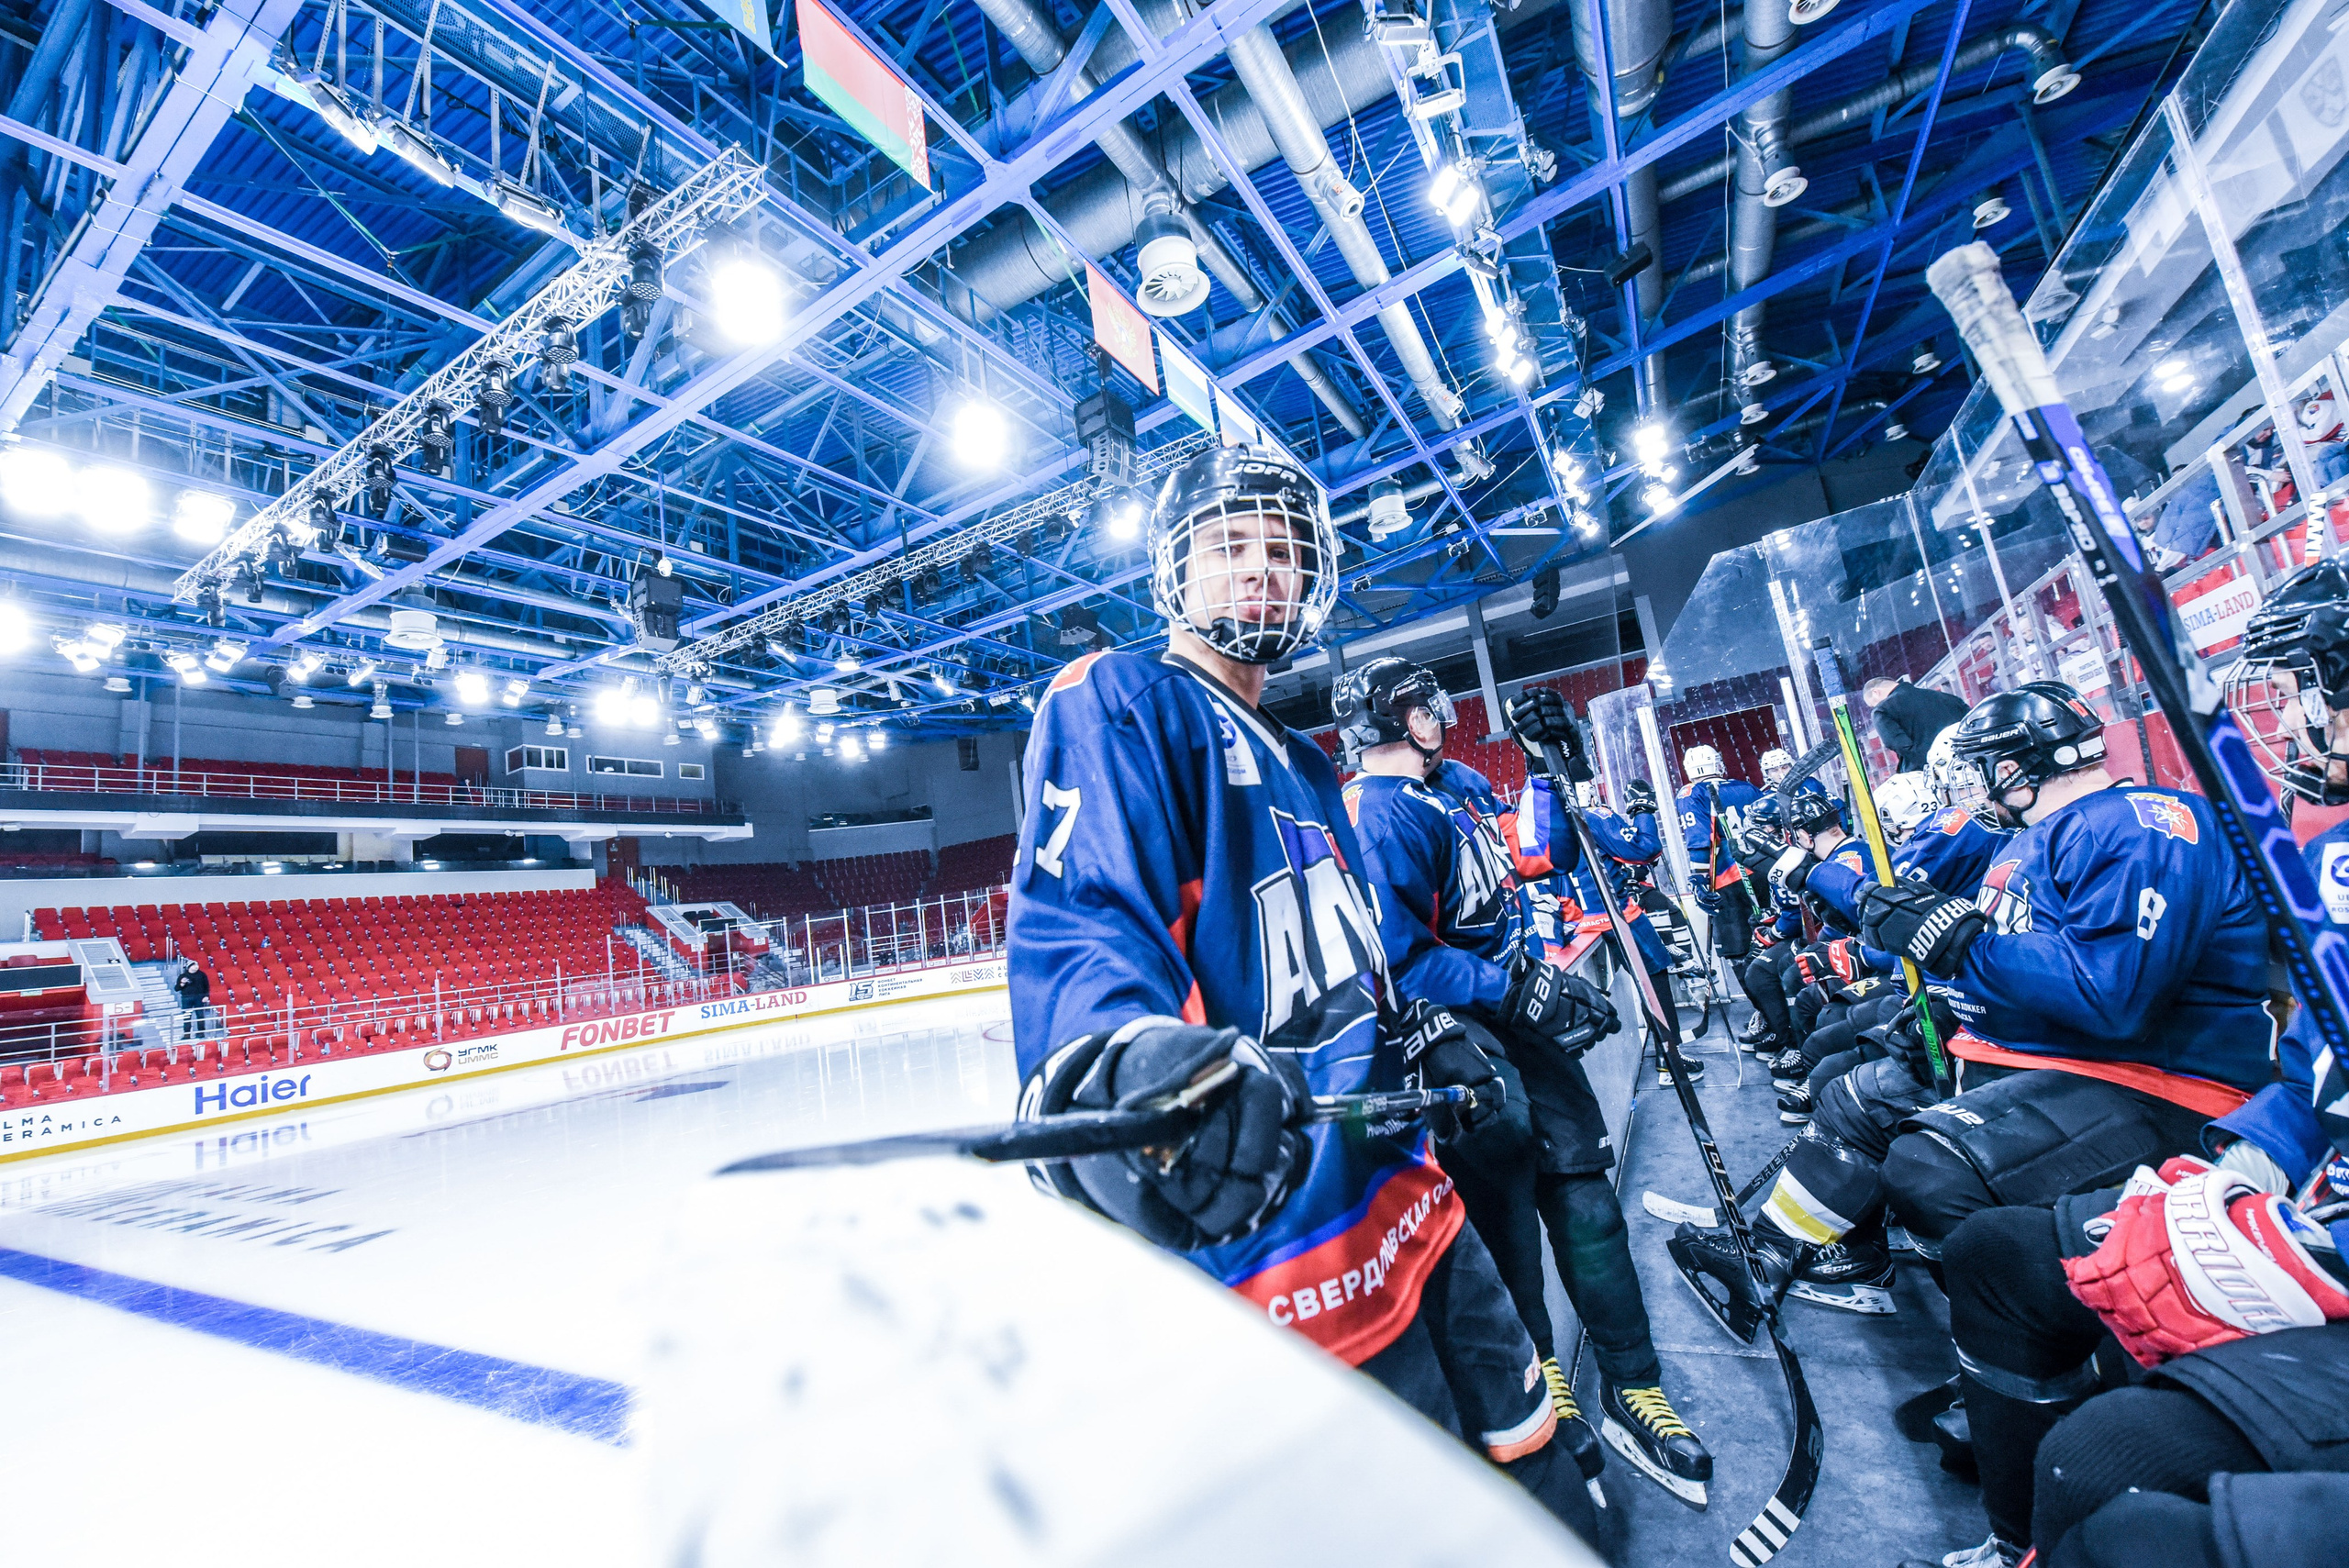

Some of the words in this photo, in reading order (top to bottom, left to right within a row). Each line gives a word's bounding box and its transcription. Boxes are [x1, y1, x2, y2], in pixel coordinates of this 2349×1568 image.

[1225, 462, 1297, 484] JOFA
[2183, 591, 2254, 633] SIMA-LAND
[1980, 728, 2020, 743] BAUER
[2001, 769, 2024, 789] BAUER
[1920, 801, 1938, 814] 23
[1034, 779, 1082, 879] 7
[1914, 895, 1936, 905] COVERT
[2137, 886, 2167, 941] 8
[1908, 897, 1976, 962] ARRIOR
[1830, 943, 1847, 976] CM
[701, 991, 807, 1019] SIMA-LAND
[561, 1011, 675, 1051] FONBET
[1404, 1011, 1459, 1062] AUE
[458, 1044, 497, 1057] УГМК
[458, 1052, 498, 1064] UMMC
[195, 1074, 311, 1115] Haier
[4, 1116, 121, 1142] ERAMICA
[1267, 1191, 1431, 1328] СВЕРДЛОВСКАЯ
[2170, 1176, 2295, 1329] ARRIOR
[1822, 1263, 1853, 1274] CCM
